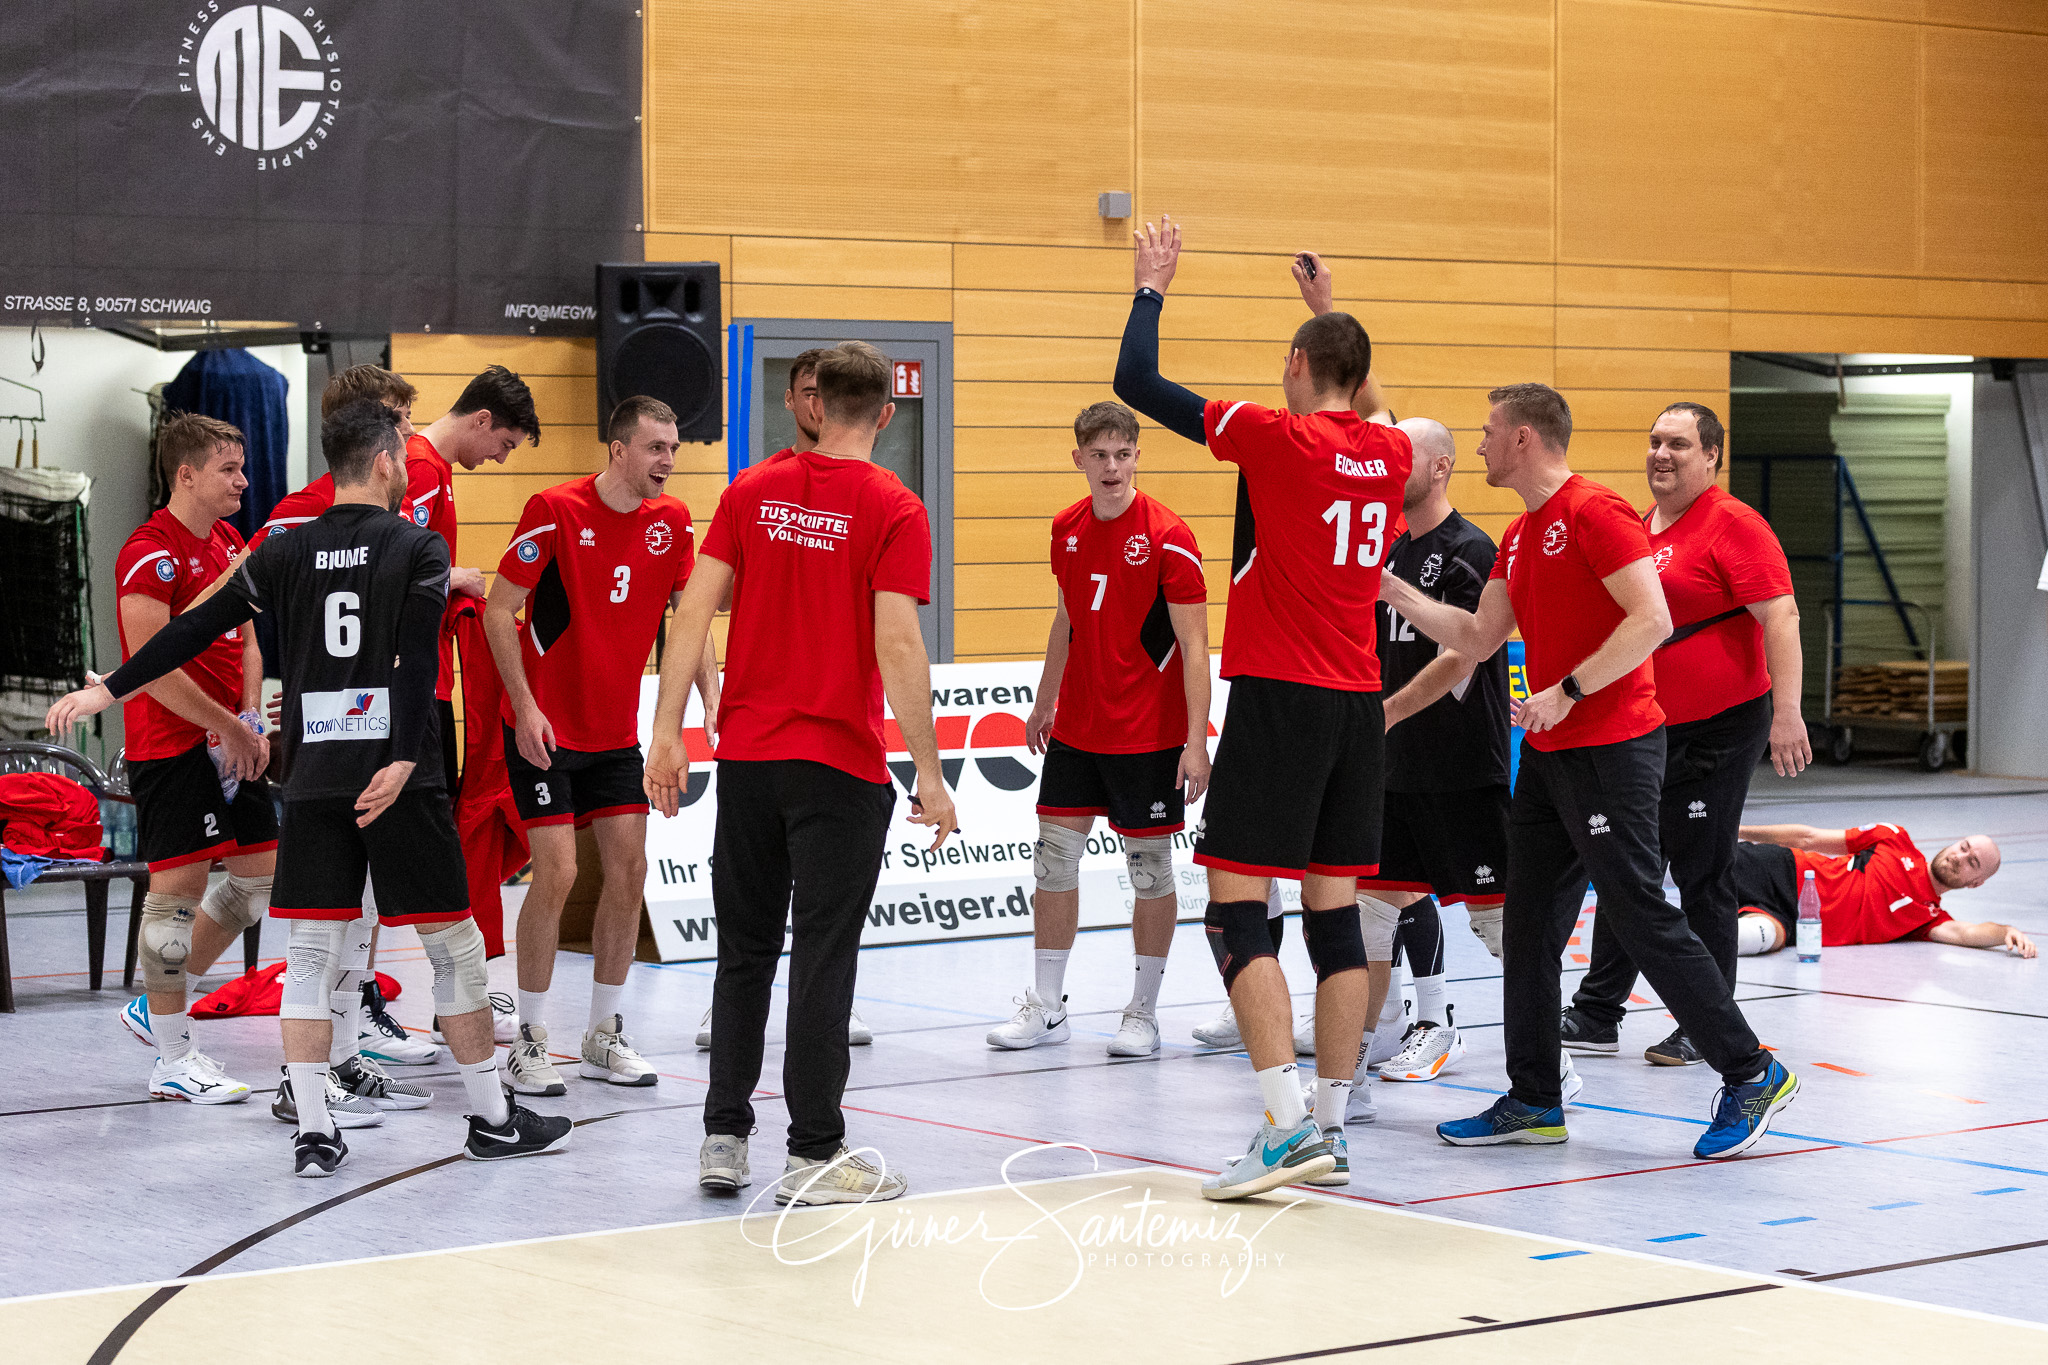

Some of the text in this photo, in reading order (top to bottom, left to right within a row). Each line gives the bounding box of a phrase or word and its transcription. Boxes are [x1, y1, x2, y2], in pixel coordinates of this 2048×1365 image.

[178, 0, 219, 92] FITNESS
[196, 5, 325, 151] ME
[257, 6, 342, 171] PHYSIOTHERAPIE
[191, 117, 227, 156] EMS
[3, 295, 212, 315] STRASSE 8, 90571 SCHWAIG
[1334, 452, 1389, 478] EICHLER
[1321, 499, 1388, 568] 13
[609, 565, 632, 604] 3
[1090, 573, 1108, 612] 7
[324, 591, 362, 659] 6
[306, 716, 389, 735] KOKINETICS
[534, 782, 552, 806] 3
[203, 812, 220, 838] 2
[658, 858, 699, 885] Ihr
[900, 840, 1037, 874] Spielware
[866, 885, 1037, 931] weiger.d
